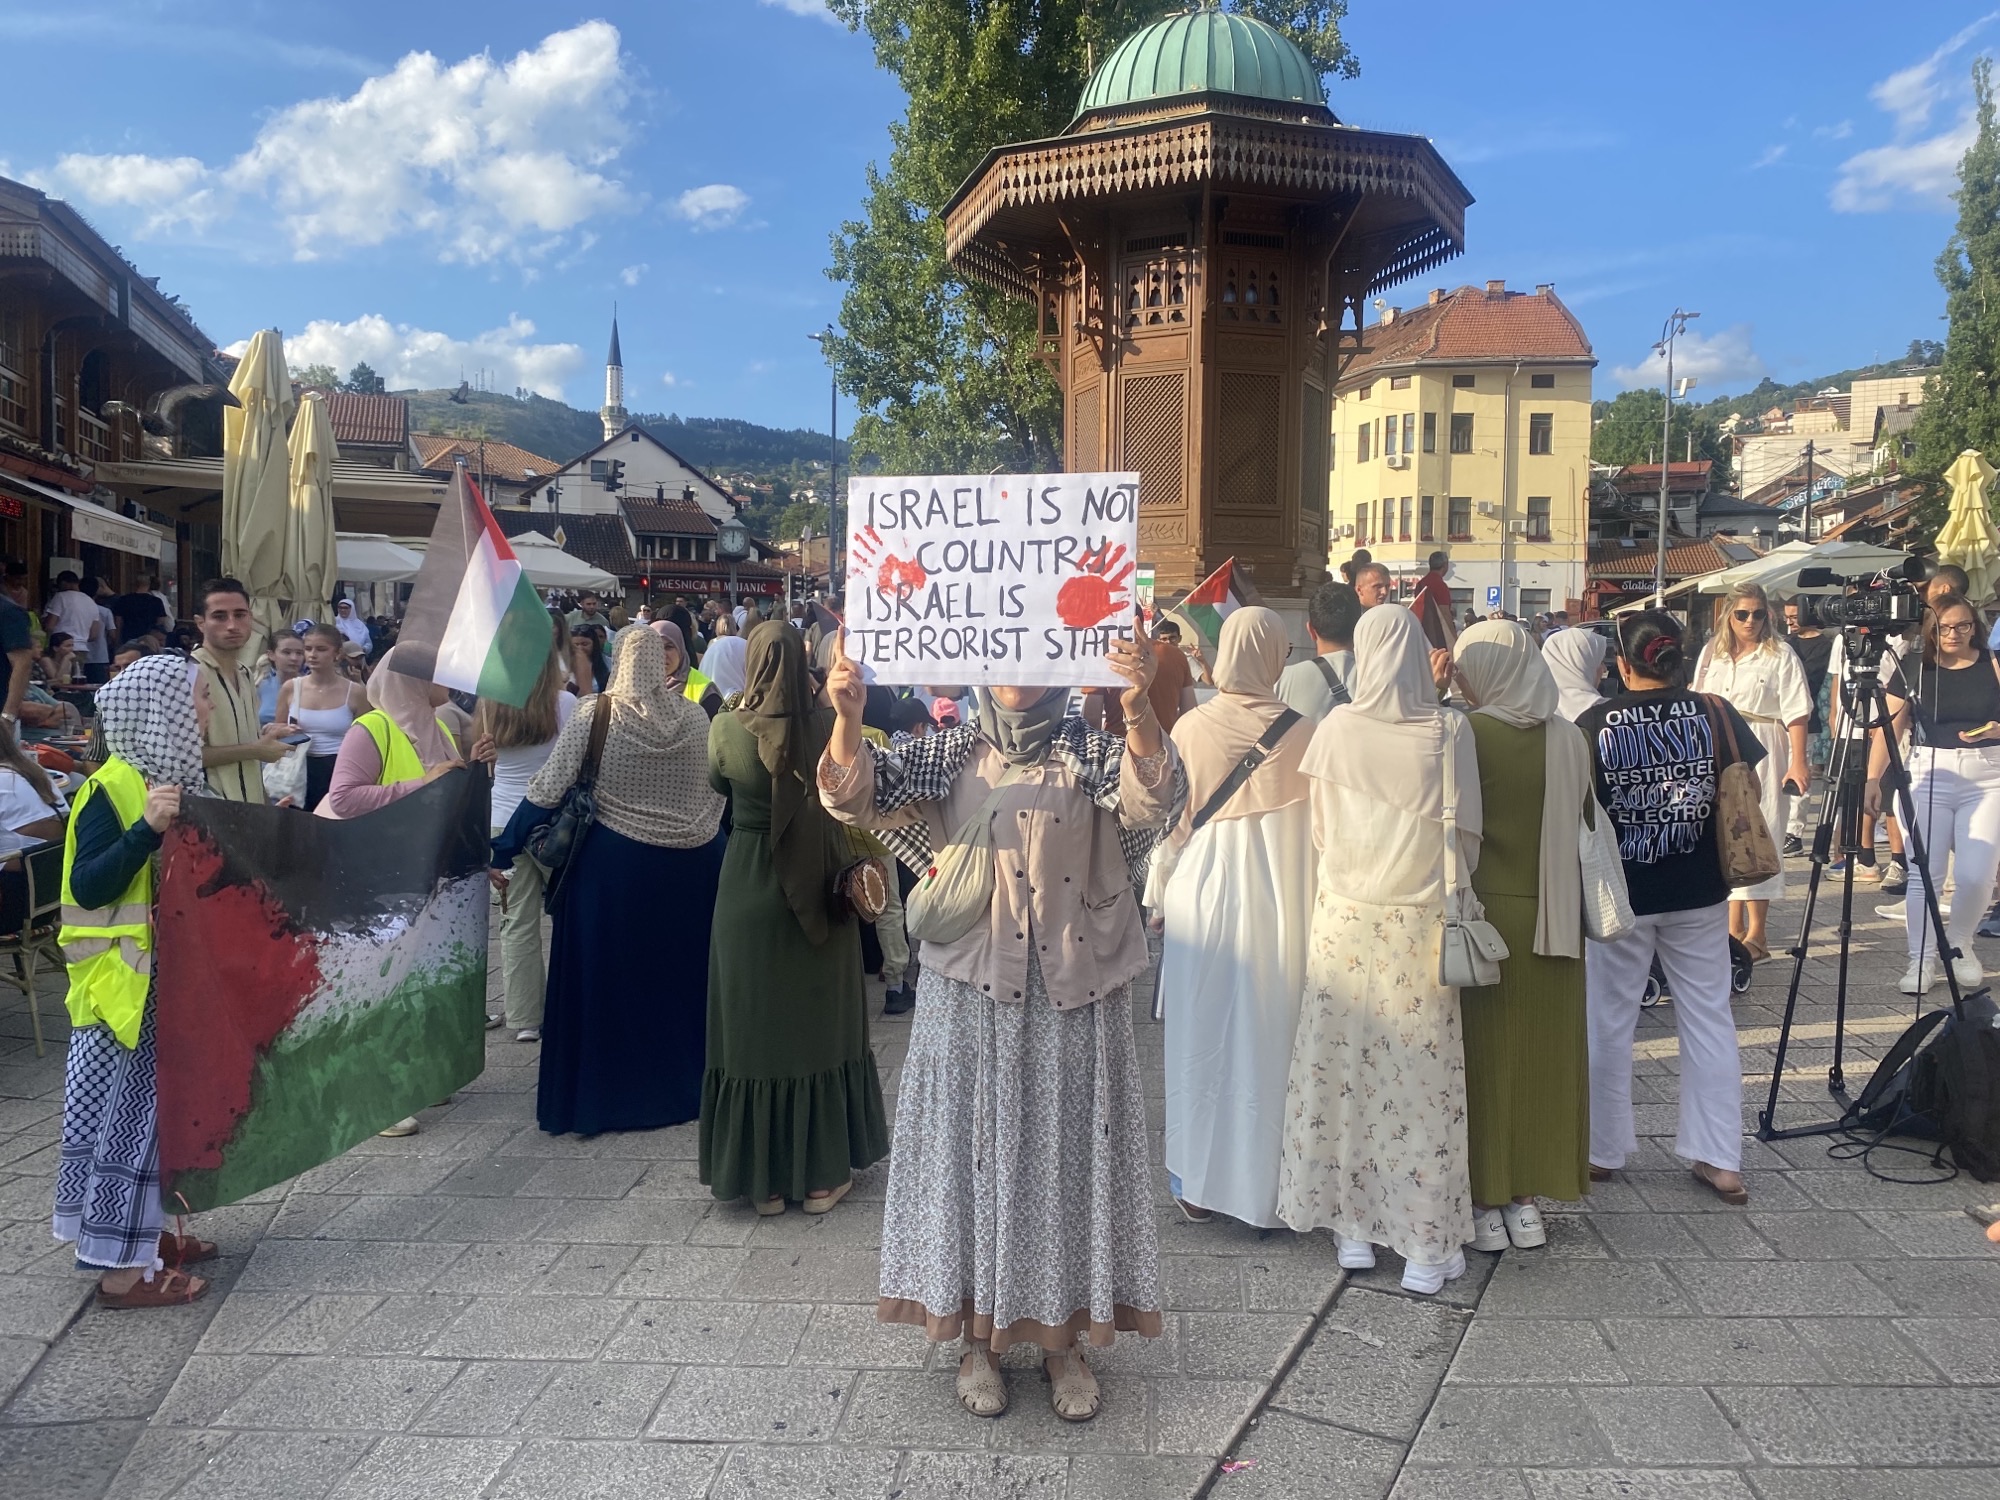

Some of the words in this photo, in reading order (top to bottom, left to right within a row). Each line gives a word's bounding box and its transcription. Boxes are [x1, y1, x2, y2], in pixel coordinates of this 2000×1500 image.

[868, 487, 1000, 530] ISRAEL
[1027, 486, 1062, 526] IS
[1081, 483, 1138, 526] NOT
[916, 535, 1107, 575] COUNTRY
[658, 578, 708, 591] MESNICA
[866, 581, 986, 623] ISRAEL
[999, 584, 1026, 618] IS
[1490, 588, 1498, 600] P
[852, 625, 1030, 665] TERRORIST
[1044, 625, 1133, 661] STATE
[1606, 704, 1663, 726] ONLY
[1669, 700, 1697, 717] 4U
[1599, 714, 1714, 770] ODISSEY
[1618, 801, 1711, 824] ELECTRO
